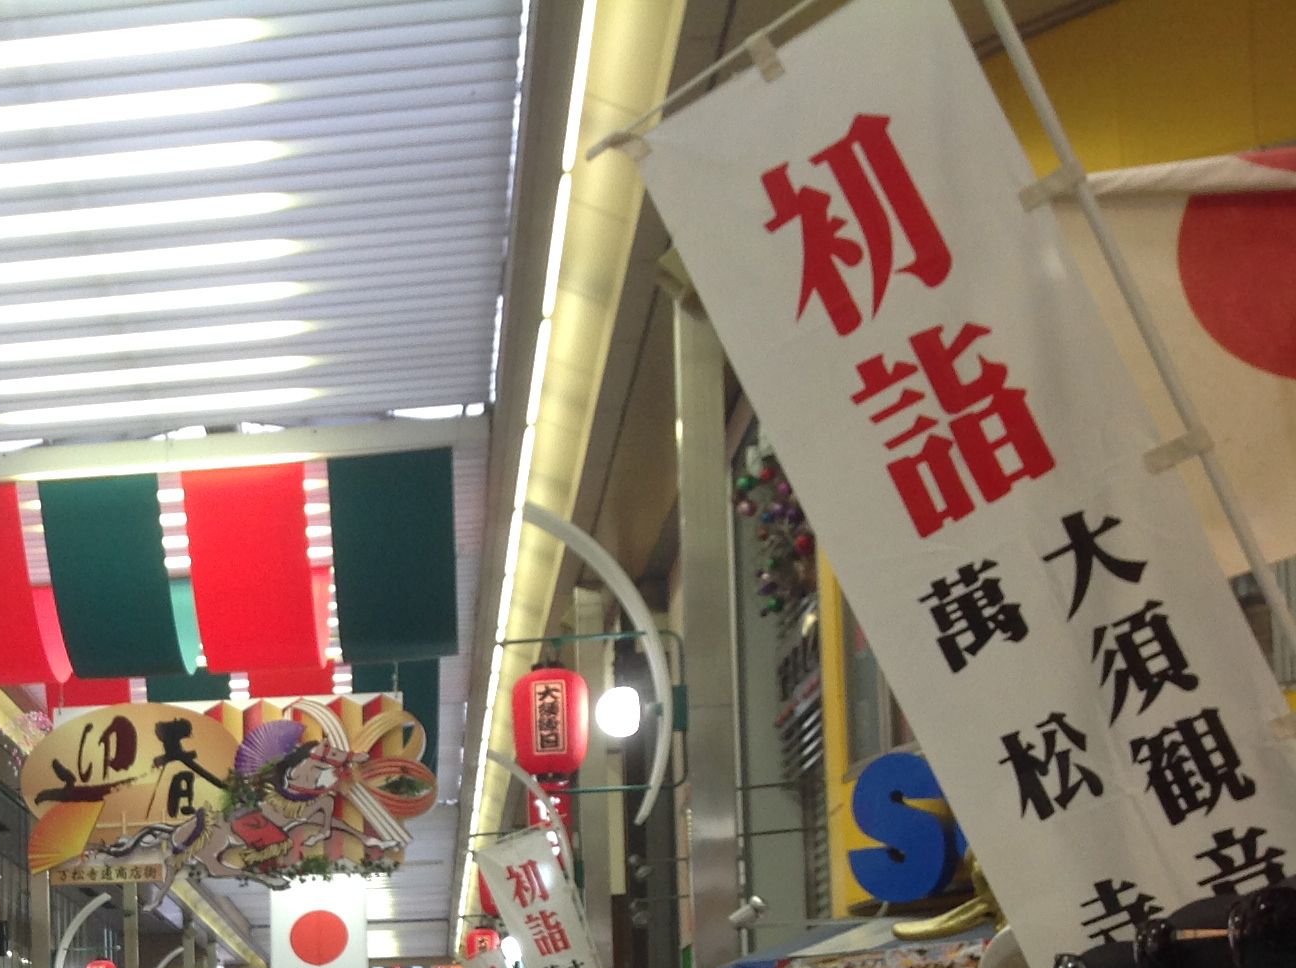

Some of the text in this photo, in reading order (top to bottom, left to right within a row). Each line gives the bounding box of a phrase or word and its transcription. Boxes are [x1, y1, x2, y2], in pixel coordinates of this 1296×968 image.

[760, 112, 1057, 539] 初詣
[34, 715, 229, 818] 迎春
[848, 752, 947, 904] S
[506, 859, 572, 957] 初詣
